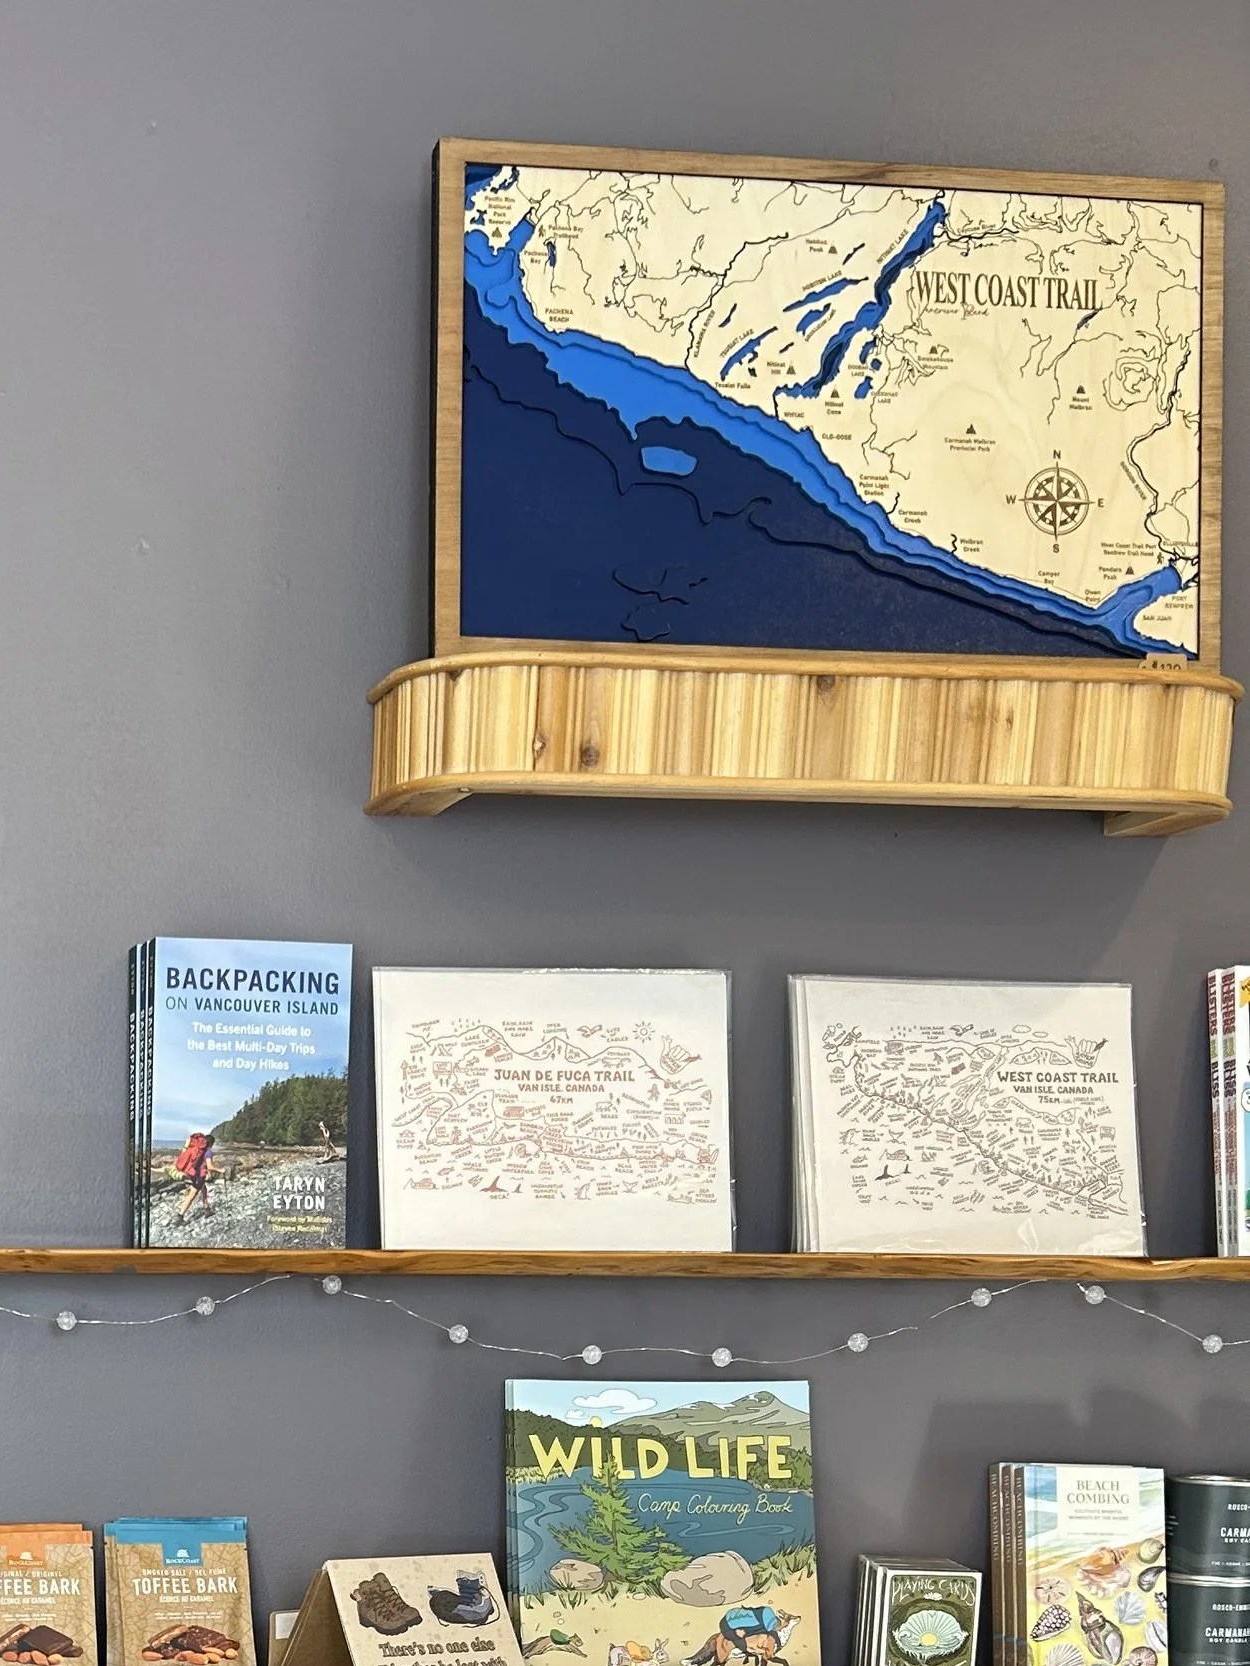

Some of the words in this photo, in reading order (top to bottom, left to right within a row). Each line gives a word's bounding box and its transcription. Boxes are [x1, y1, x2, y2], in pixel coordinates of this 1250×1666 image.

[915, 271, 971, 304] WEST
[974, 273, 1040, 308] COAST
[1043, 277, 1103, 310] TRAIL
[1053, 450, 1061, 459] N
[1005, 495, 1016, 504] W
[1098, 498, 1104, 507] E
[1053, 544, 1060, 553] S
[166, 967, 339, 995] BACKPACKING
[166, 996, 188, 1010] ON
[195, 997, 281, 1013] VANCOUVER
[287, 1001, 339, 1015] ISLAND
[192, 1022, 213, 1034] The
[216, 1022, 263, 1035] Essential
[266, 1024, 297, 1037] Guide
[300, 1025, 312, 1037] to
[187, 1039, 204, 1051] the
[208, 1040, 232, 1051] Best
[235, 1041, 287, 1056] Multi-Day
[290, 1043, 315, 1055] Trips
[213, 1057, 233, 1069] and
[236, 1058, 257, 1071] Day
[260, 1059, 290, 1071] Hikes
[494, 1069, 530, 1081] JUAN
[535, 1070, 553, 1081] DE
[557, 1070, 591, 1082] FUCA
[594, 1070, 635, 1082] TRAIL
[997, 1072, 1033, 1083] WEST
[1036, 1073, 1077, 1083] COAST
[1080, 1073, 1119, 1083] TRAIL
[518, 1084, 538, 1092] VAN
[565, 1084, 604, 1092] CANADA
[1013, 1086, 1033, 1094] VAN
[1057, 1086, 1094, 1094] CANADA
[273, 1175, 325, 1192] TARYN
[273, 1195, 325, 1210] EYTON
[528, 1434, 669, 1480] WILD
[684, 1435, 792, 1480] LIFE
[1077, 1480, 1120, 1491] BEACH
[1067, 1493, 1130, 1505] COMBING
[638, 1493, 681, 1520] Camp
[687, 1494, 750, 1525] Colouring
[754, 1494, 794, 1513] Book
[39, 1579, 81, 1595] BARK
[132, 1578, 191, 1595] TOFFEE
[197, 1577, 238, 1593] BARK
[892, 1578, 935, 1605] PLAYING
[939, 1580, 975, 1606] CARDS
[378, 1642, 426, 1657] There's
[427, 1643, 444, 1654] no
[446, 1642, 469, 1653] one
[471, 1637, 496, 1652] else
